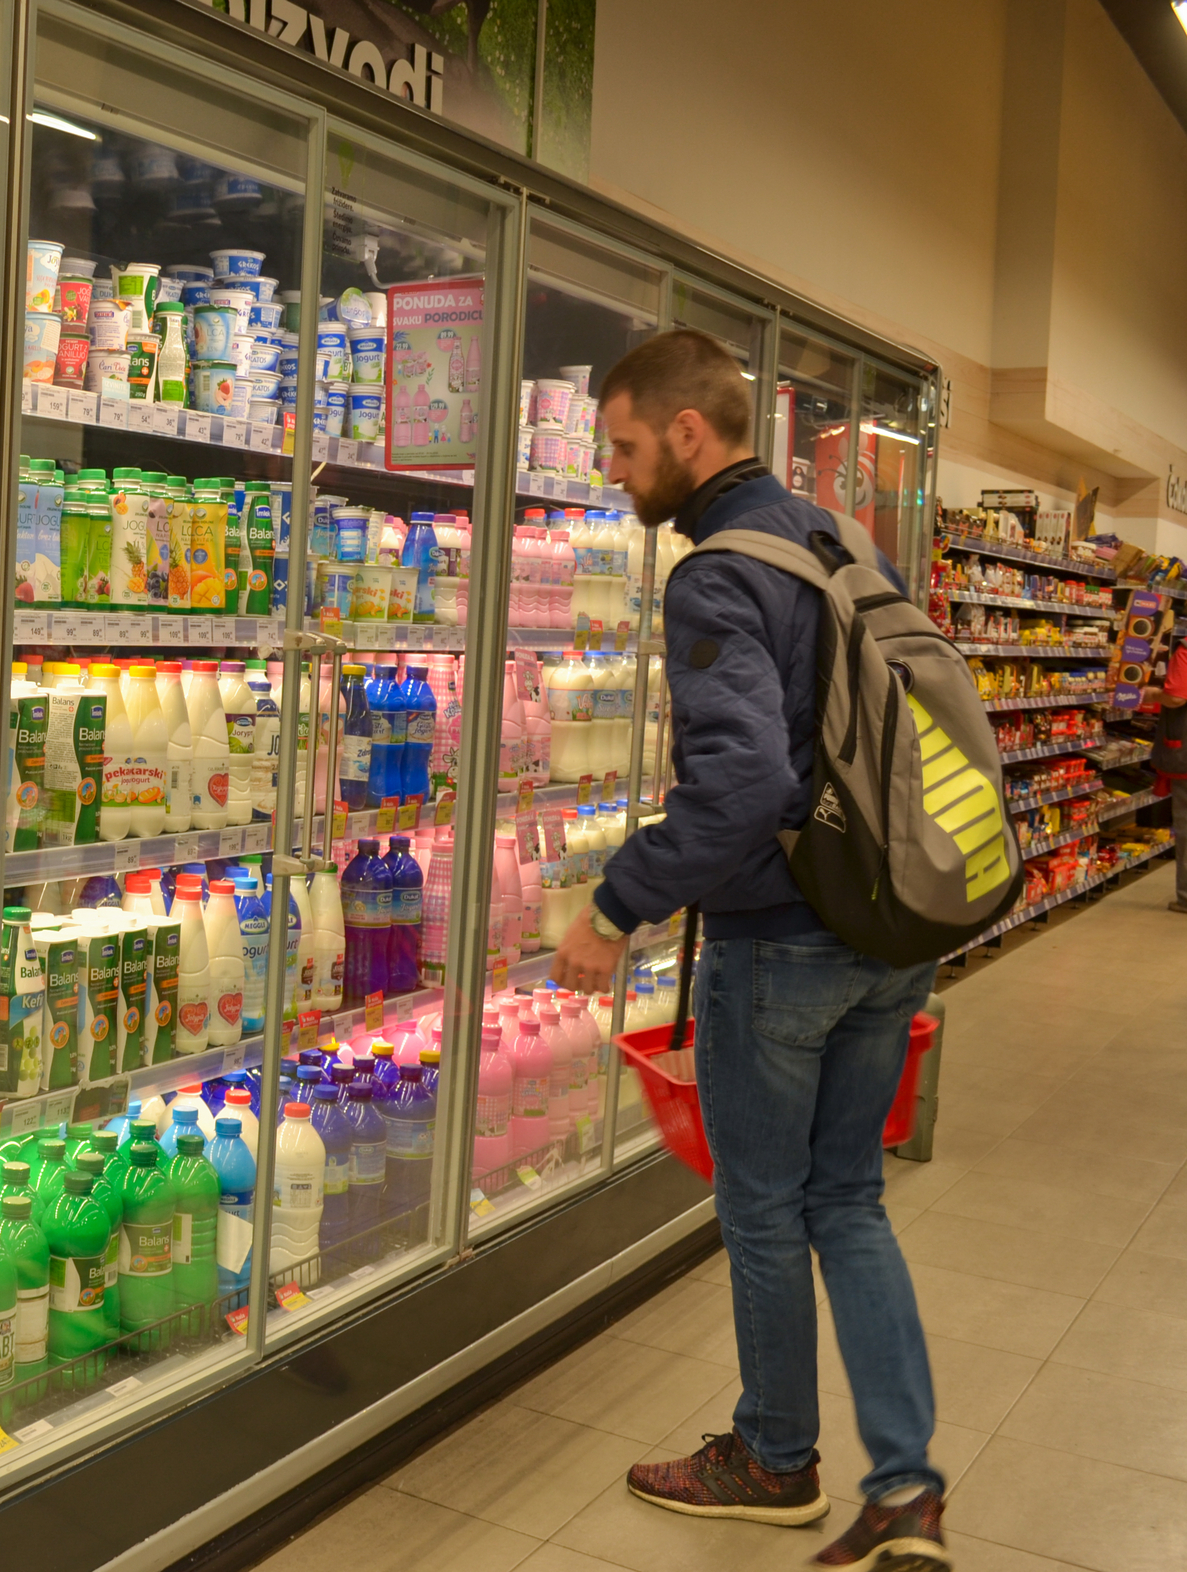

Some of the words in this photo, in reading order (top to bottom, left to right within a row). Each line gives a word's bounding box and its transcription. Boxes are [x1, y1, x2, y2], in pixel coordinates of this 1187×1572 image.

[393, 294, 456, 311] PONUDA
[458, 296, 473, 307] ZA
[393, 315, 422, 326] SVAKU
[355, 353, 380, 364] Jogurt
[49, 402, 60, 411] 159
[30, 627, 41, 636] 149
[66, 628, 74, 636] 99
[93, 629, 100, 637] 89
[119, 630, 126, 639] 89
[140, 630, 147, 638] 99
[169, 630, 179, 639] 109
[198, 631, 208, 640] 109
[222, 632, 231, 640] 109
[52, 696, 75, 707] Balans
[907, 693, 1011, 903] PUMA
[244, 921, 267, 930] MEGGLE
[90, 966, 120, 981] Balans
[50, 972, 79, 987] Balans
[23, 1117, 34, 1126] 122
[139, 1235, 170, 1248] Balans
